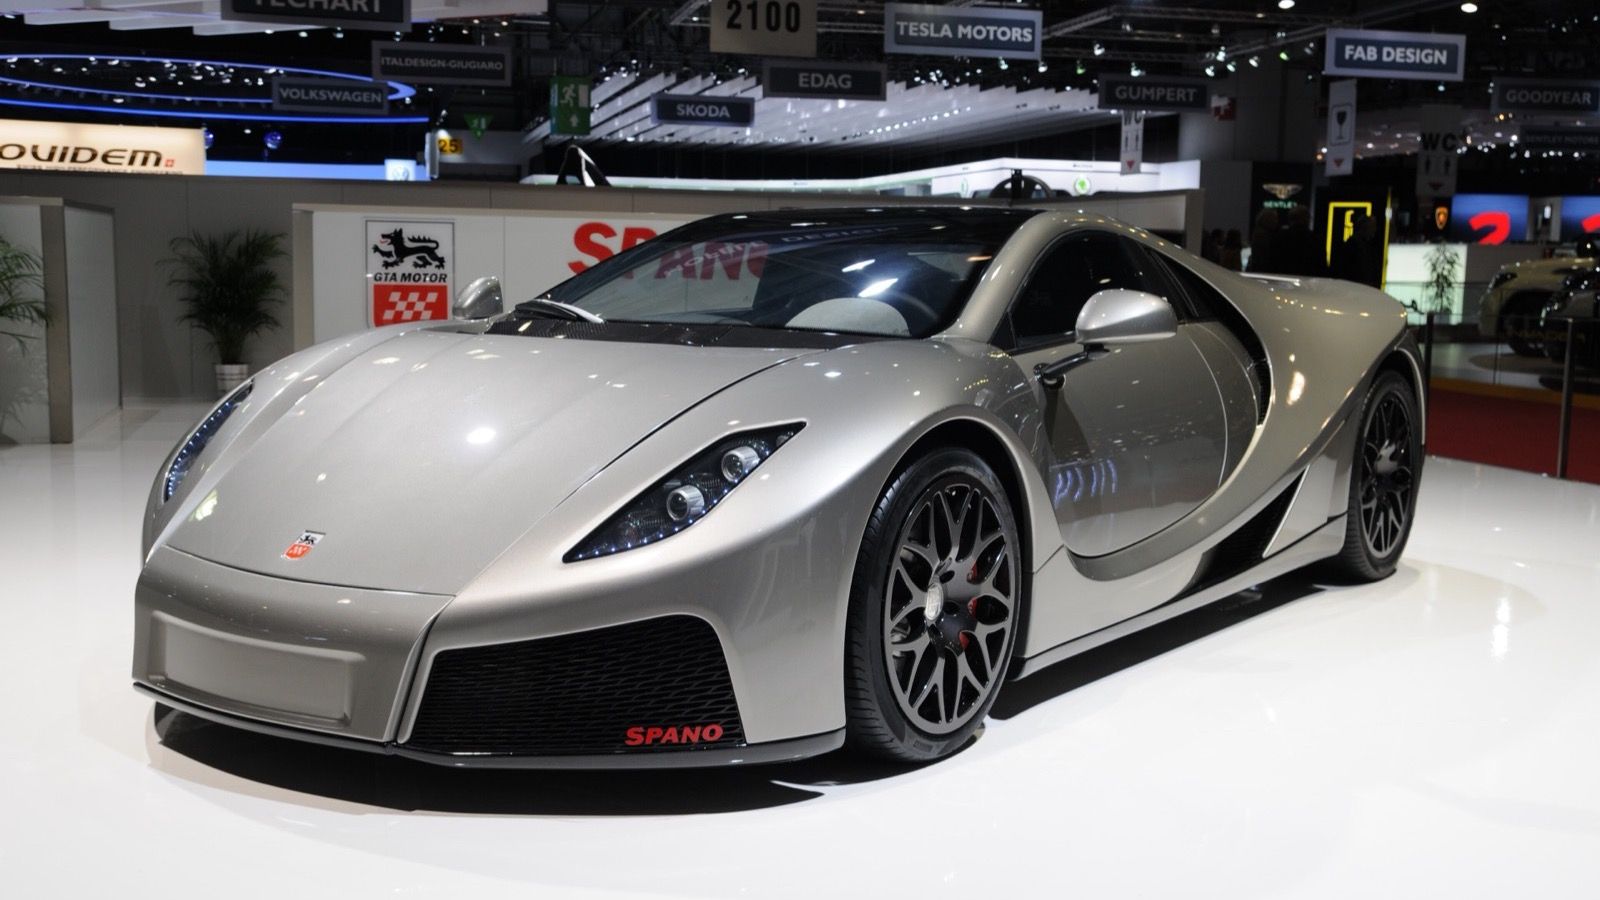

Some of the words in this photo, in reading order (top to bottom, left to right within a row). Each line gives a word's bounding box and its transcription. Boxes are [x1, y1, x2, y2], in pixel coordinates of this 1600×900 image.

[726, 0, 801, 33] 2100
[896, 21, 953, 39] TESLA
[957, 25, 1033, 44] MOTORS
[1344, 45, 1378, 62] FAB
[1382, 47, 1448, 65] DESIGN
[380, 56, 504, 71] ITALDESIGN-GIUGIARO
[798, 73, 853, 90] EDAG
[279, 88, 383, 104] VOLKSWAGEN
[1115, 86, 1197, 102] GUMPERT
[1506, 89, 1592, 105] GOODYEAR
[676, 103, 730, 119] SKODA
[1422, 133, 1457, 151] WC
[374, 271, 398, 283] GTA
[400, 272, 448, 284] MOTOR
[625, 724, 724, 746] SPANO
